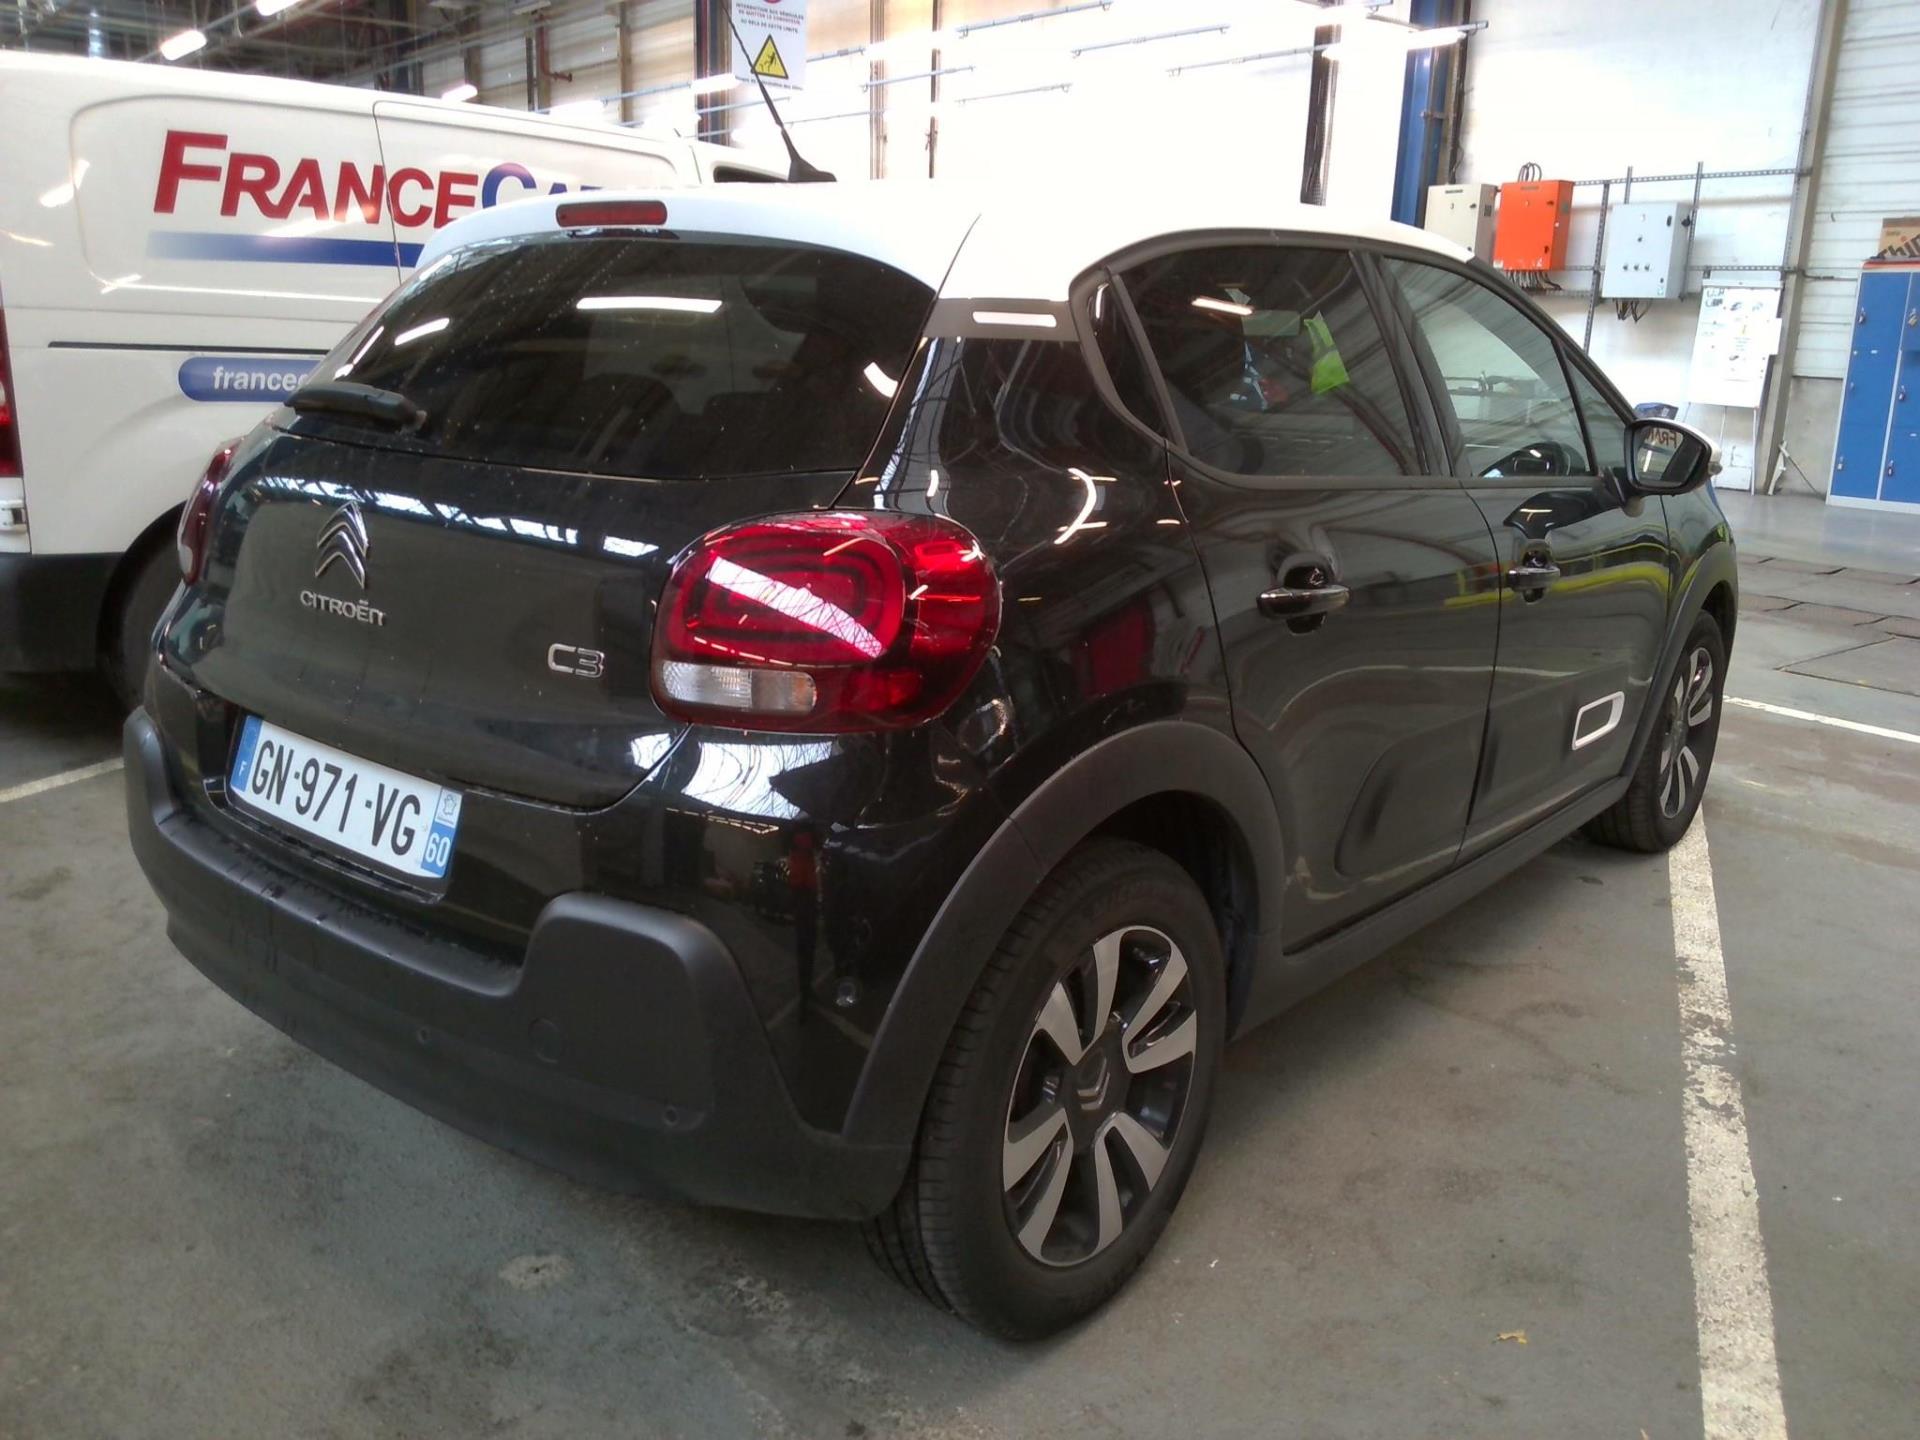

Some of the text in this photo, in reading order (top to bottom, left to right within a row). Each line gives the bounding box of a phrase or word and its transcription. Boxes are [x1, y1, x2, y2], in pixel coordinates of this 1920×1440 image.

[300, 590, 384, 626] CITROËN
[547, 643, 605, 678] C3
[425, 832, 451, 868] 60
